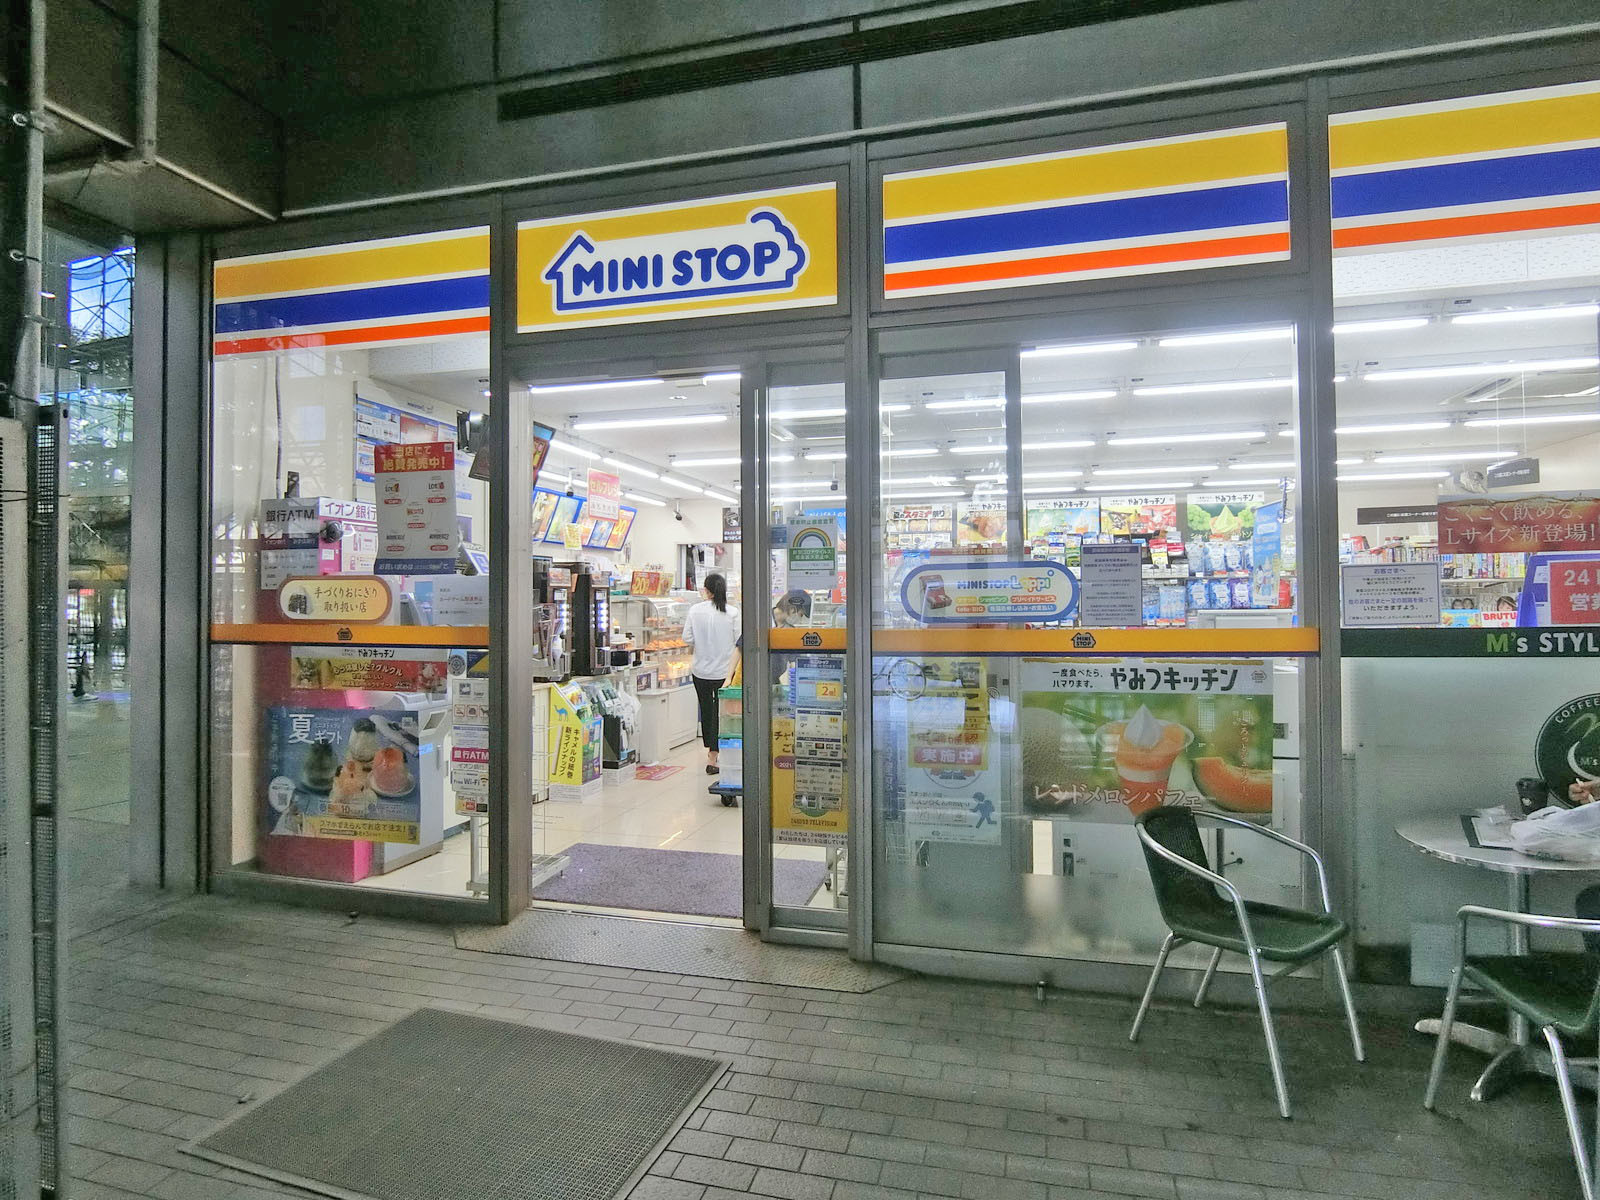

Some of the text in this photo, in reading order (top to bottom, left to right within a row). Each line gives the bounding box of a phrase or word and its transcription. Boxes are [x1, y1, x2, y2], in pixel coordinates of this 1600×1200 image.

[573, 241, 780, 296] MINI STOP
[391, 445, 432, 457] 当店にて
[266, 509, 315, 522] 銀行ATM
[325, 502, 376, 520] イオン銀行
[1444, 503, 1585, 523] ごくごく飲める、
[1447, 523, 1595, 545] Lサイズ新登場!
[957, 579, 1011, 589] MINISTOP
[314, 586, 377, 599] 手づくりおにぎり
[323, 601, 367, 613] 取り扱い店
[1486, 632, 1528, 653] M's
[358, 649, 395, 658] やみつキッチン
[1052, 668, 1104, 678] 一度食べたら、
[1110, 666, 1239, 691] やみつキッチン
[1052, 679, 1093, 689] ハマります。
[1555, 697, 1600, 724] COFFEE
[288, 713, 315, 744] 夏
[314, 730, 342, 745] ギフト
[454, 750, 489, 760] 銀行ATM
[922, 748, 974, 763] 実施中
[464, 778, 480, 786] Wi-Fi
